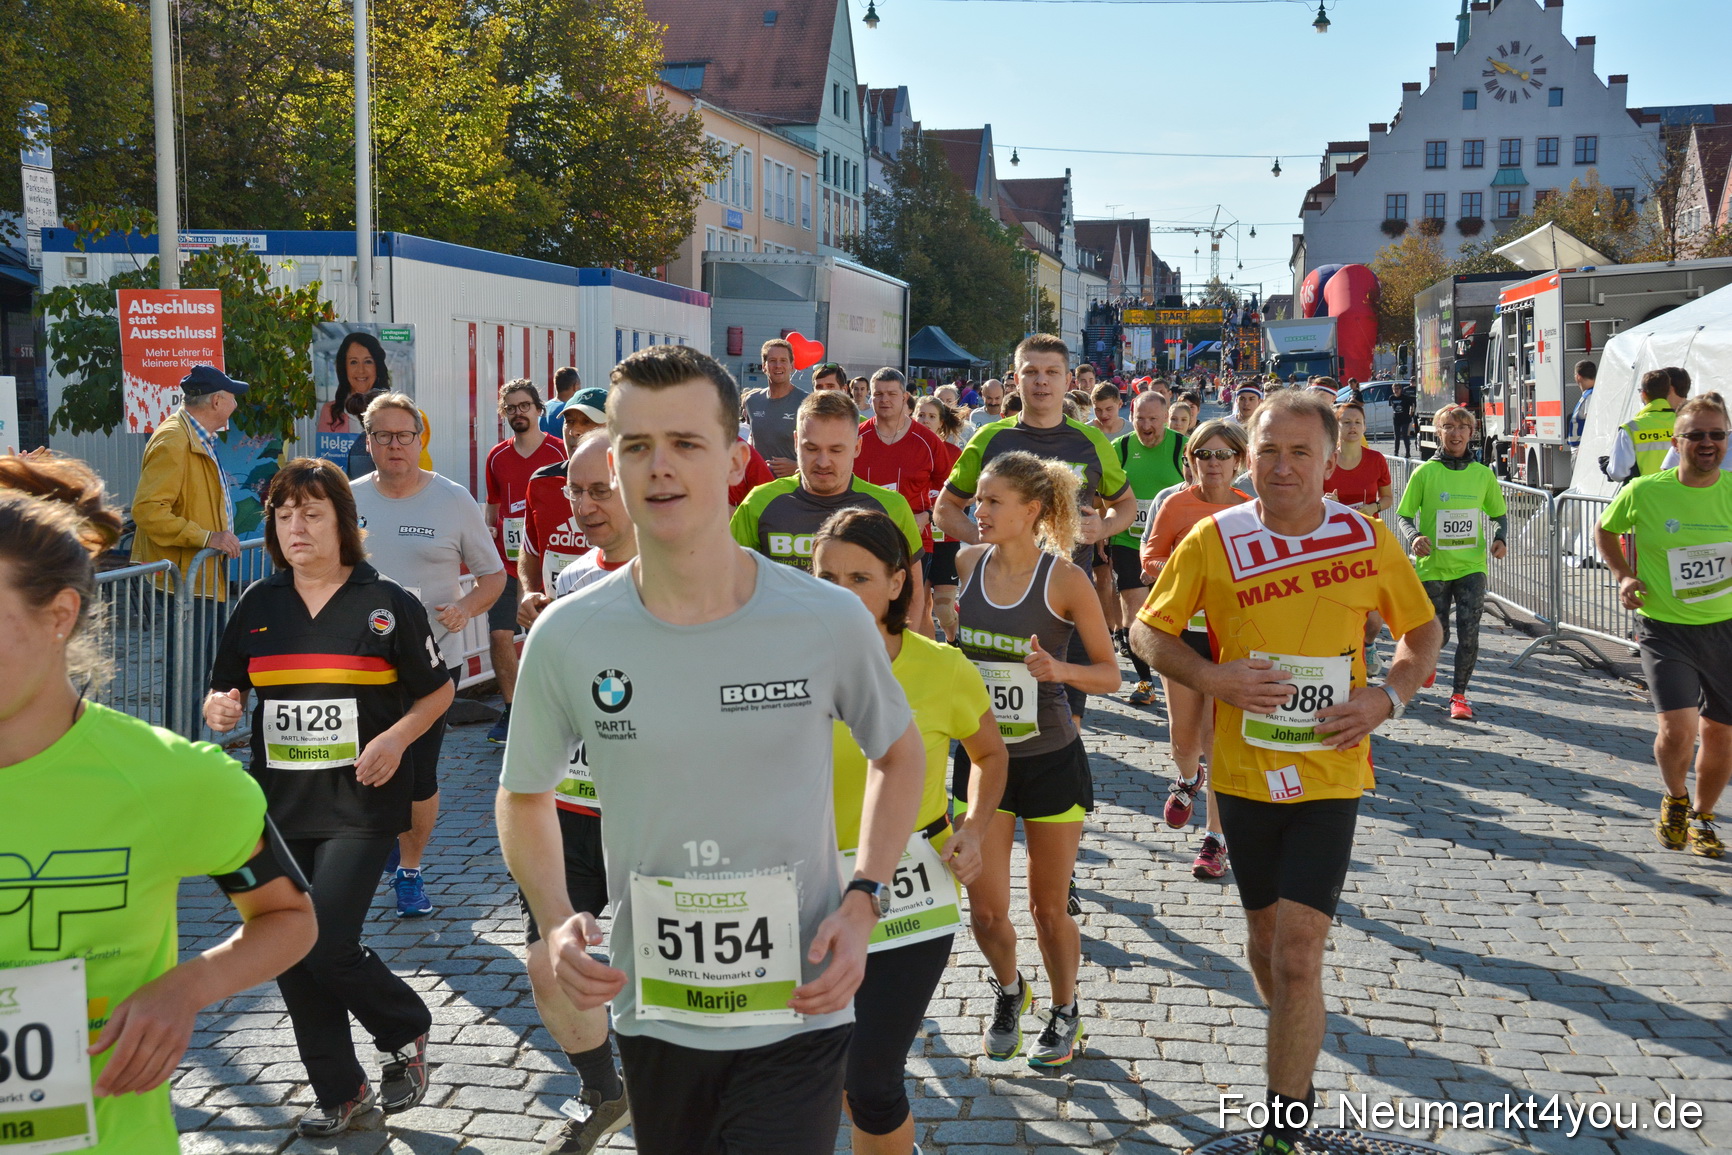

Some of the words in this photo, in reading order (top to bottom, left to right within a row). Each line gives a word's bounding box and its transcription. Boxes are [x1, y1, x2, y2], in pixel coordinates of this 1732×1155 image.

[128, 299, 215, 314] Abschluss
[129, 316, 157, 324] statt
[1156, 312, 1190, 321] START
[130, 326, 216, 339] Ausschluss!
[172, 348, 200, 356] Lehrer
[202, 348, 214, 356] für
[142, 359, 178, 367] kleinere
[321, 436, 354, 453] Helga
[400, 526, 435, 536] BOCK
[1443, 520, 1472, 533] 5029
[1680, 556, 1726, 580] 5217
[1236, 576, 1304, 608] MAX
[1311, 559, 1378, 589] BÖGL
[960, 625, 1039, 655] BOCK
[594, 670, 630, 685] BMW
[720, 679, 810, 705] BOCK
[1265, 682, 1334, 713] 088
[783, 700, 812, 708] concepts
[276, 705, 342, 731] 5128
[1266, 714, 1287, 722] PARTL
[595, 720, 636, 731] PARTL
[999, 725, 1012, 735] tin
[598, 732, 637, 740] Neumarkt
[289, 748, 329, 759] Christa
[579, 783, 597, 796] Fra
[682, 840, 730, 867] 19.
[675, 891, 748, 908] BOCK
[890, 901, 923, 914] Neumarkt
[885, 918, 920, 936] Hilde
[658, 916, 773, 964] 5154
[669, 968, 700, 979] PARTL
[703, 971, 751, 980] Neumarkt
[687, 990, 747, 1012] Marije
